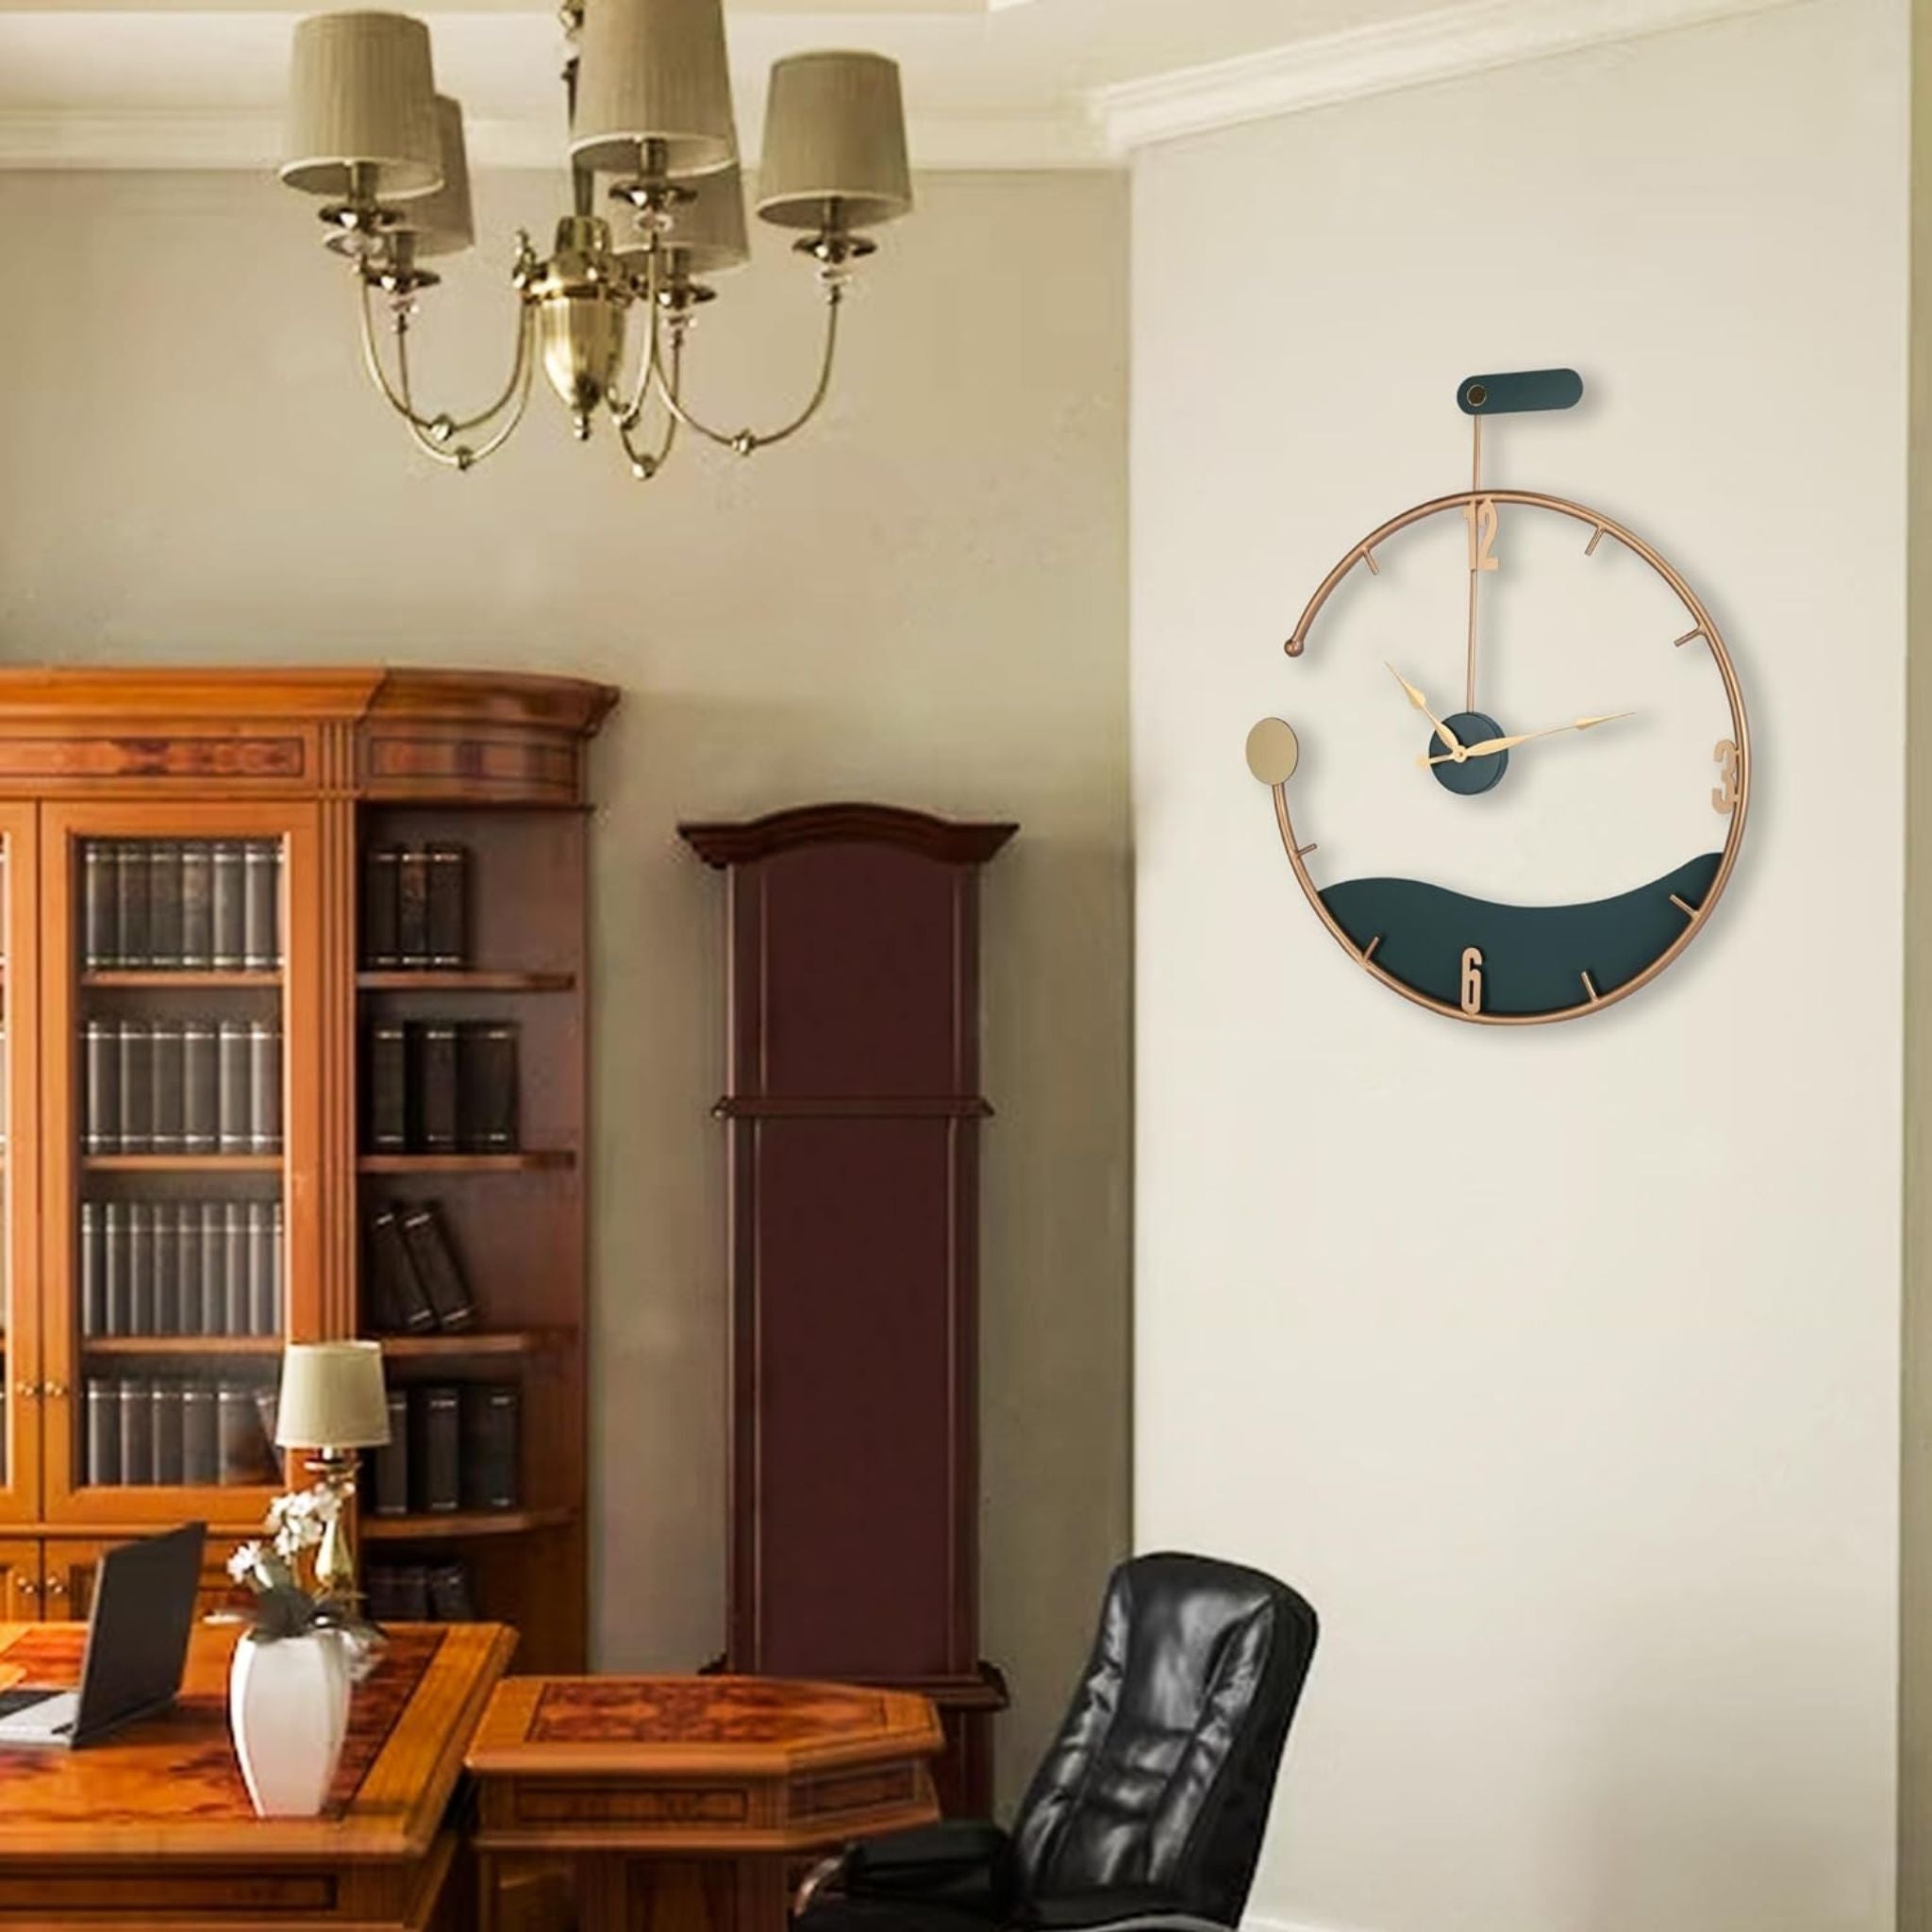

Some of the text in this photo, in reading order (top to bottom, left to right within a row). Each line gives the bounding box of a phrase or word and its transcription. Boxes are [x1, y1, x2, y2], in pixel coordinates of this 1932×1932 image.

[1463, 500, 1498, 571] 12
[1712, 740, 1737, 814] 3
[1461, 947, 1482, 1014] 6
